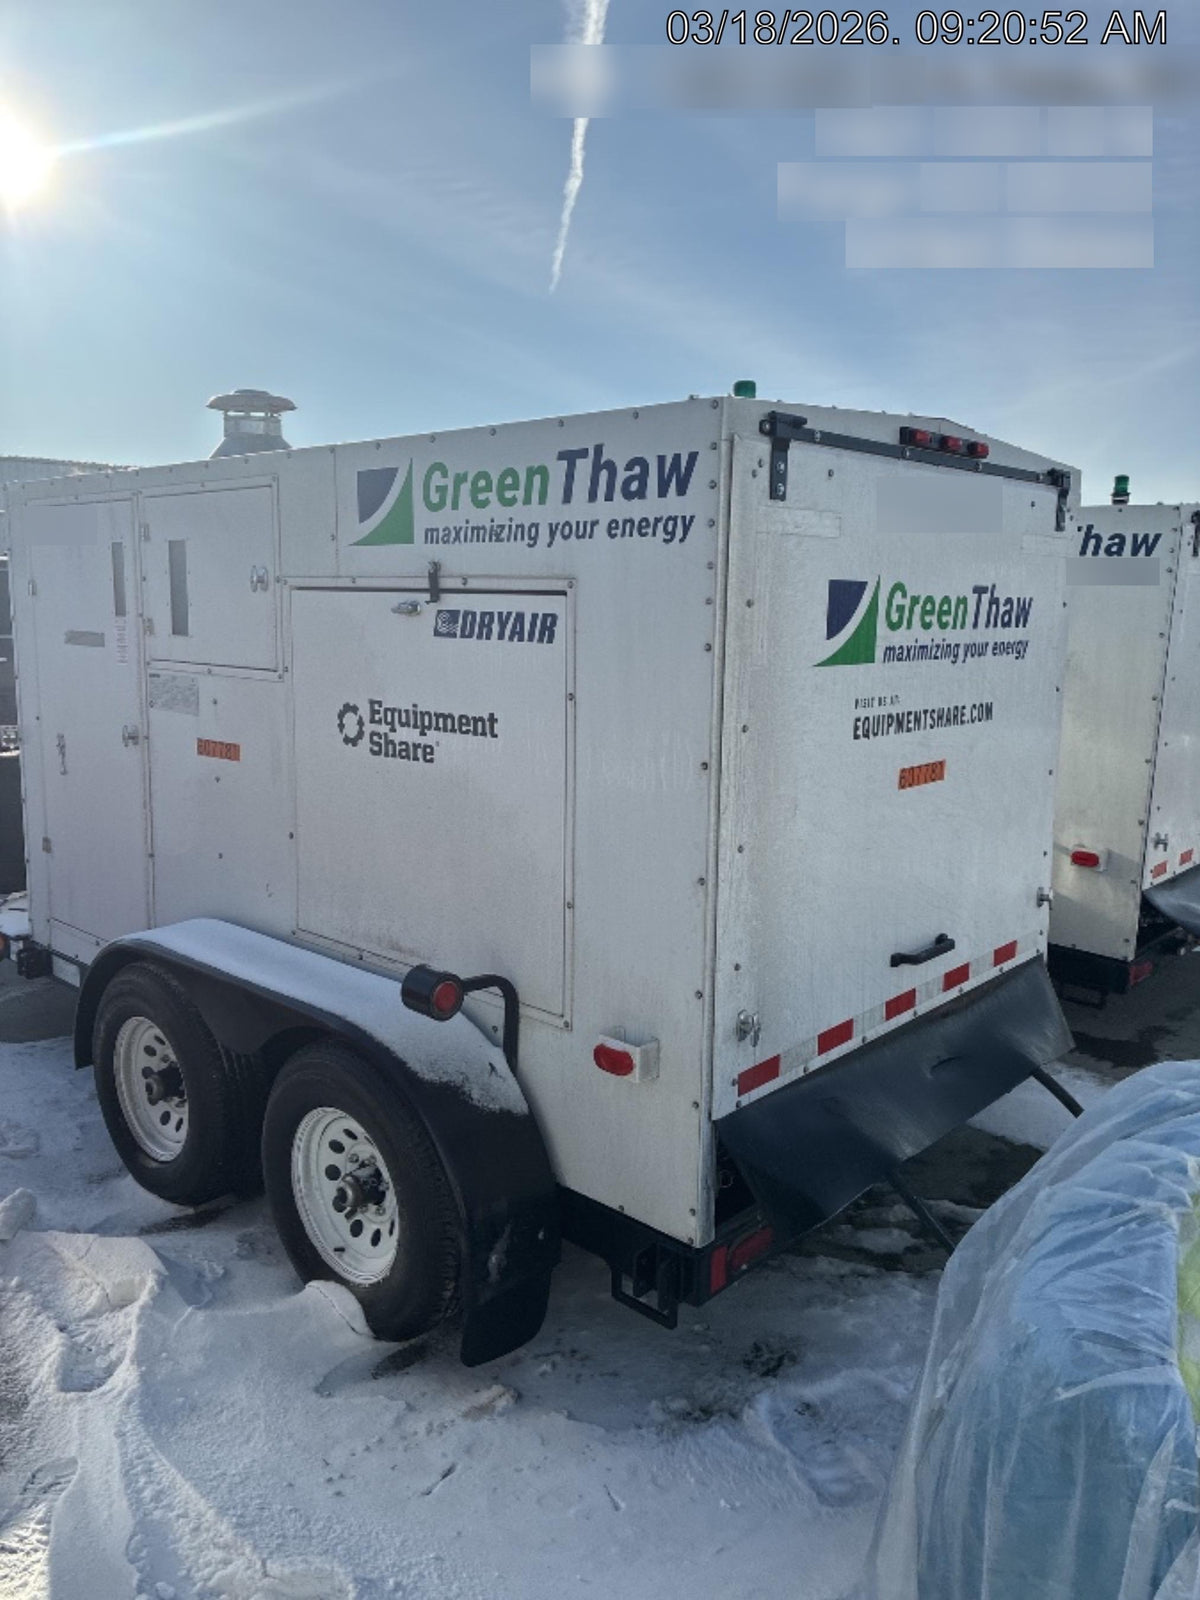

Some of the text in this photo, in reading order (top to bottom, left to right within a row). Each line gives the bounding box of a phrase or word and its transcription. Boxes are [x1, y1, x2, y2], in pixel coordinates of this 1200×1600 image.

[423, 514, 695, 548] maximizing your energy
[1078, 524, 1162, 557] haw
[458, 609, 559, 645] DRYAIR
[883, 638, 1029, 665] maximizing your energy
[368, 698, 499, 740] Equipment
[853, 702, 994, 740] EQUIPMENTSHARE.COM
